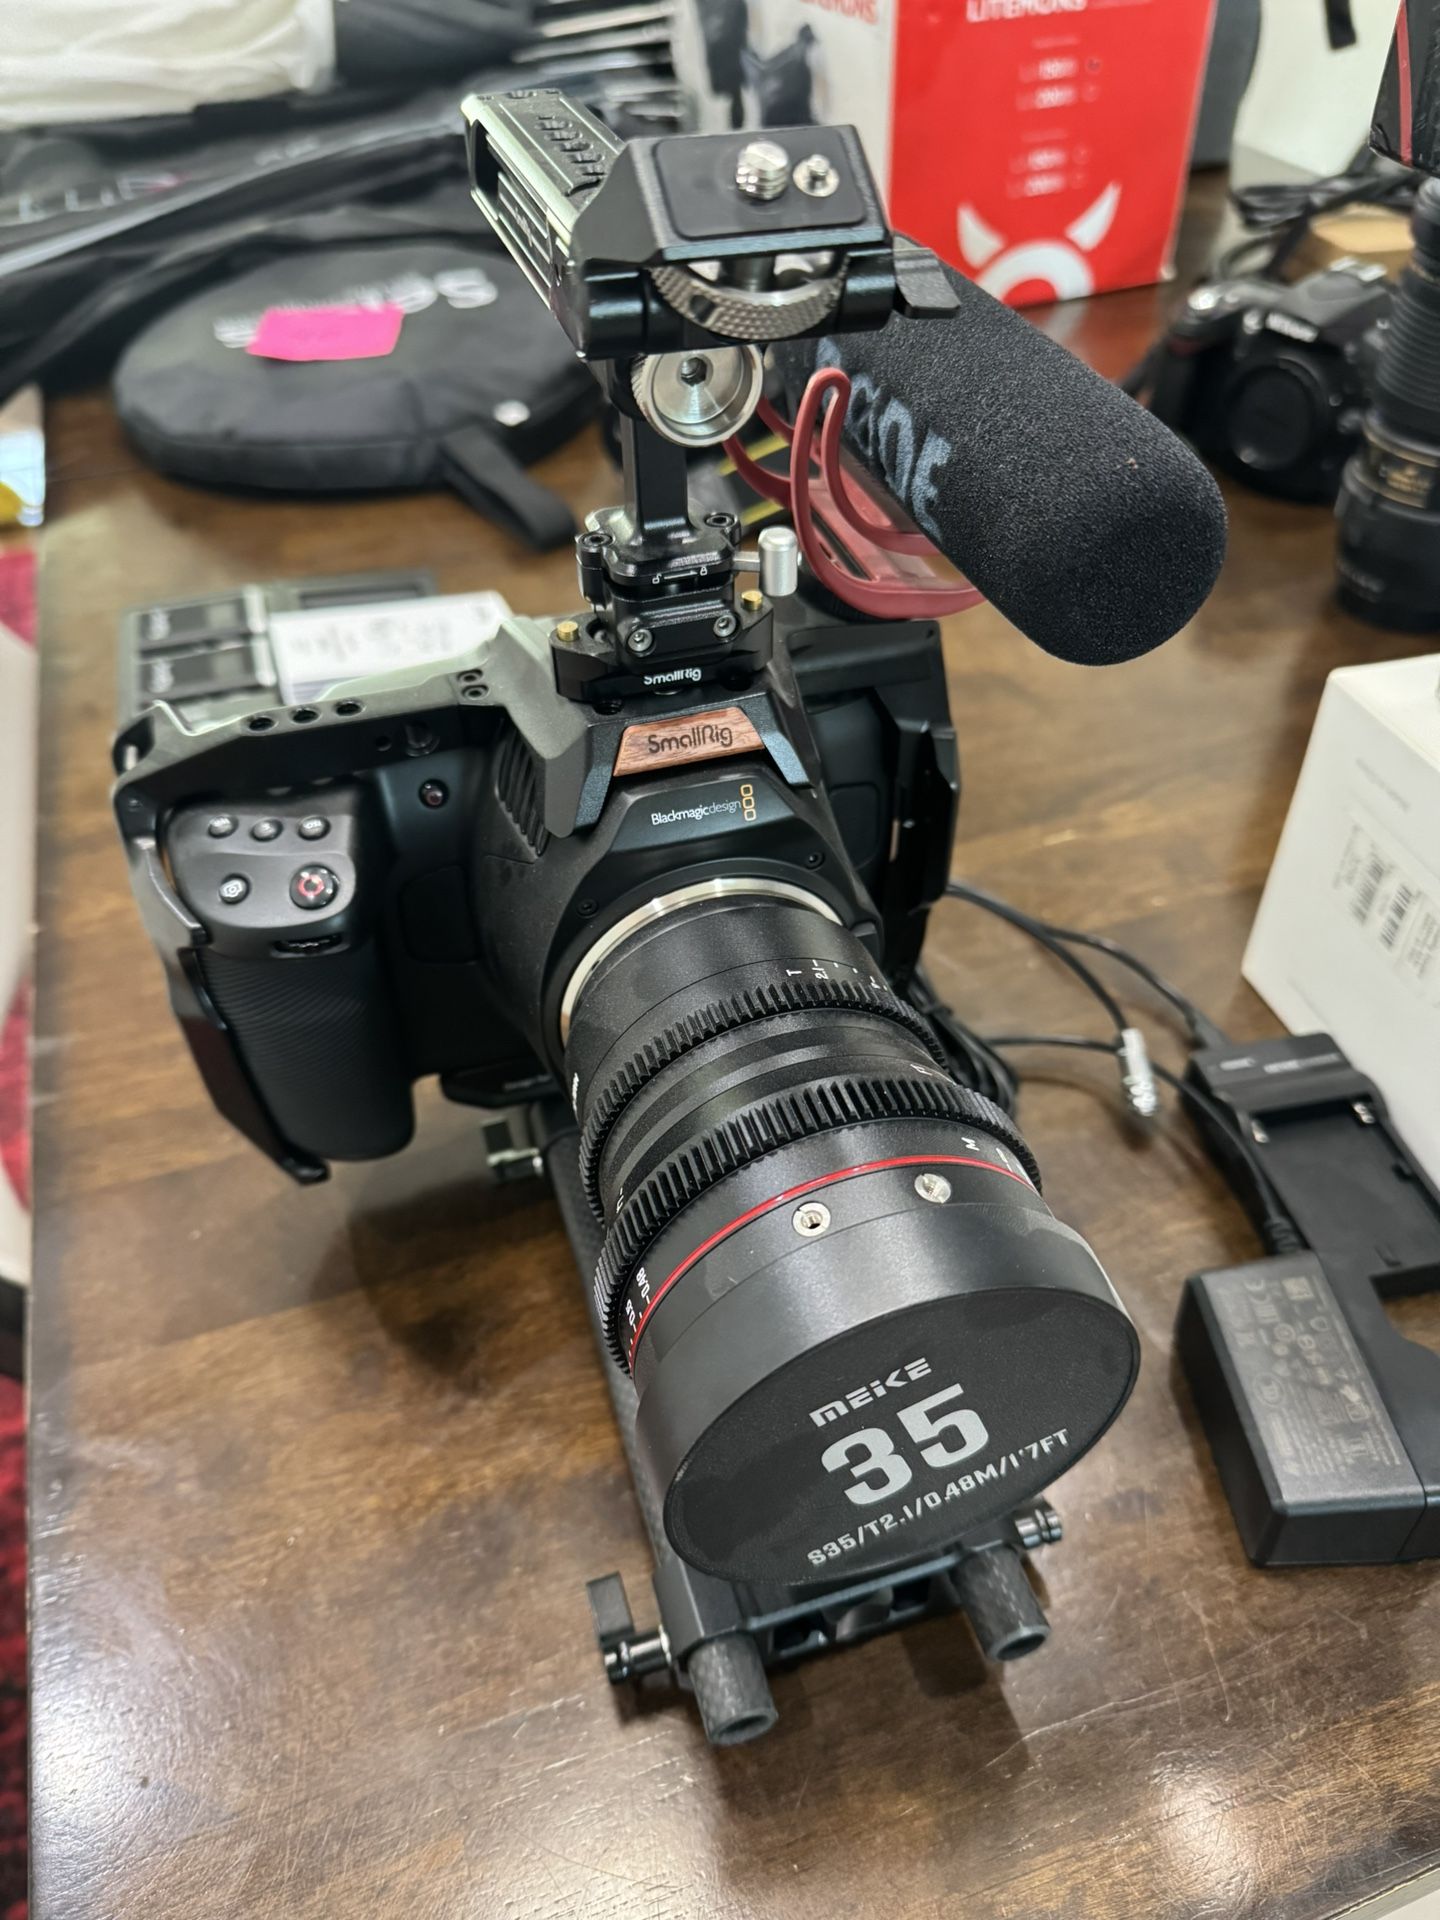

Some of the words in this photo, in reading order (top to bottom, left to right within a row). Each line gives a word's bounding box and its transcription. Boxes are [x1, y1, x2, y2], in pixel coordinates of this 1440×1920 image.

[643, 667, 702, 686] SmallRig
[648, 725, 734, 754] SmallRig
[809, 1357, 932, 1427] MEIKE
[821, 1383, 989, 1505] 35
